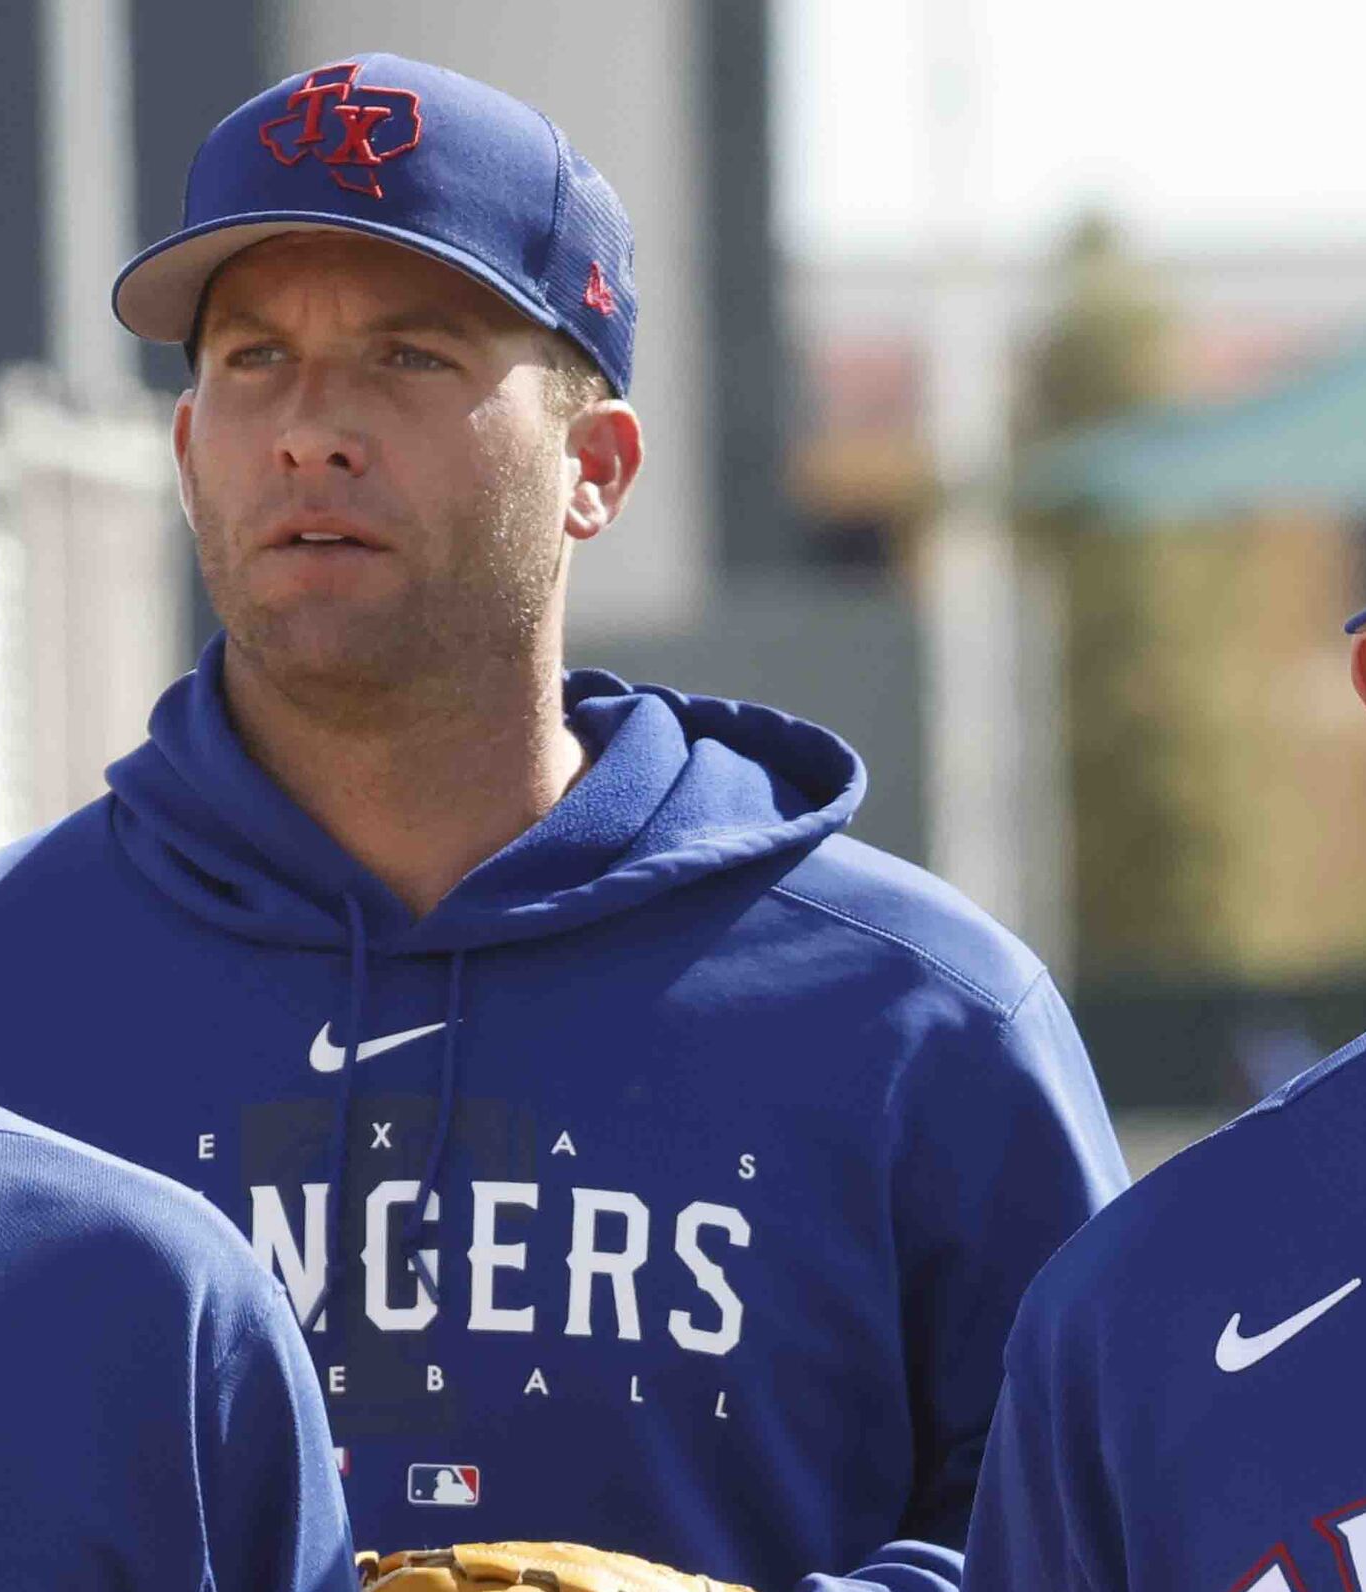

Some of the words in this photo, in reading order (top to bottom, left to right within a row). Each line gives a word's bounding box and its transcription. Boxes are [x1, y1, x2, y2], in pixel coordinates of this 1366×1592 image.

[197, 1122, 757, 1181] EXAS
[248, 1179, 752, 1356] NGERS
[328, 1364, 728, 1418] EBALL
